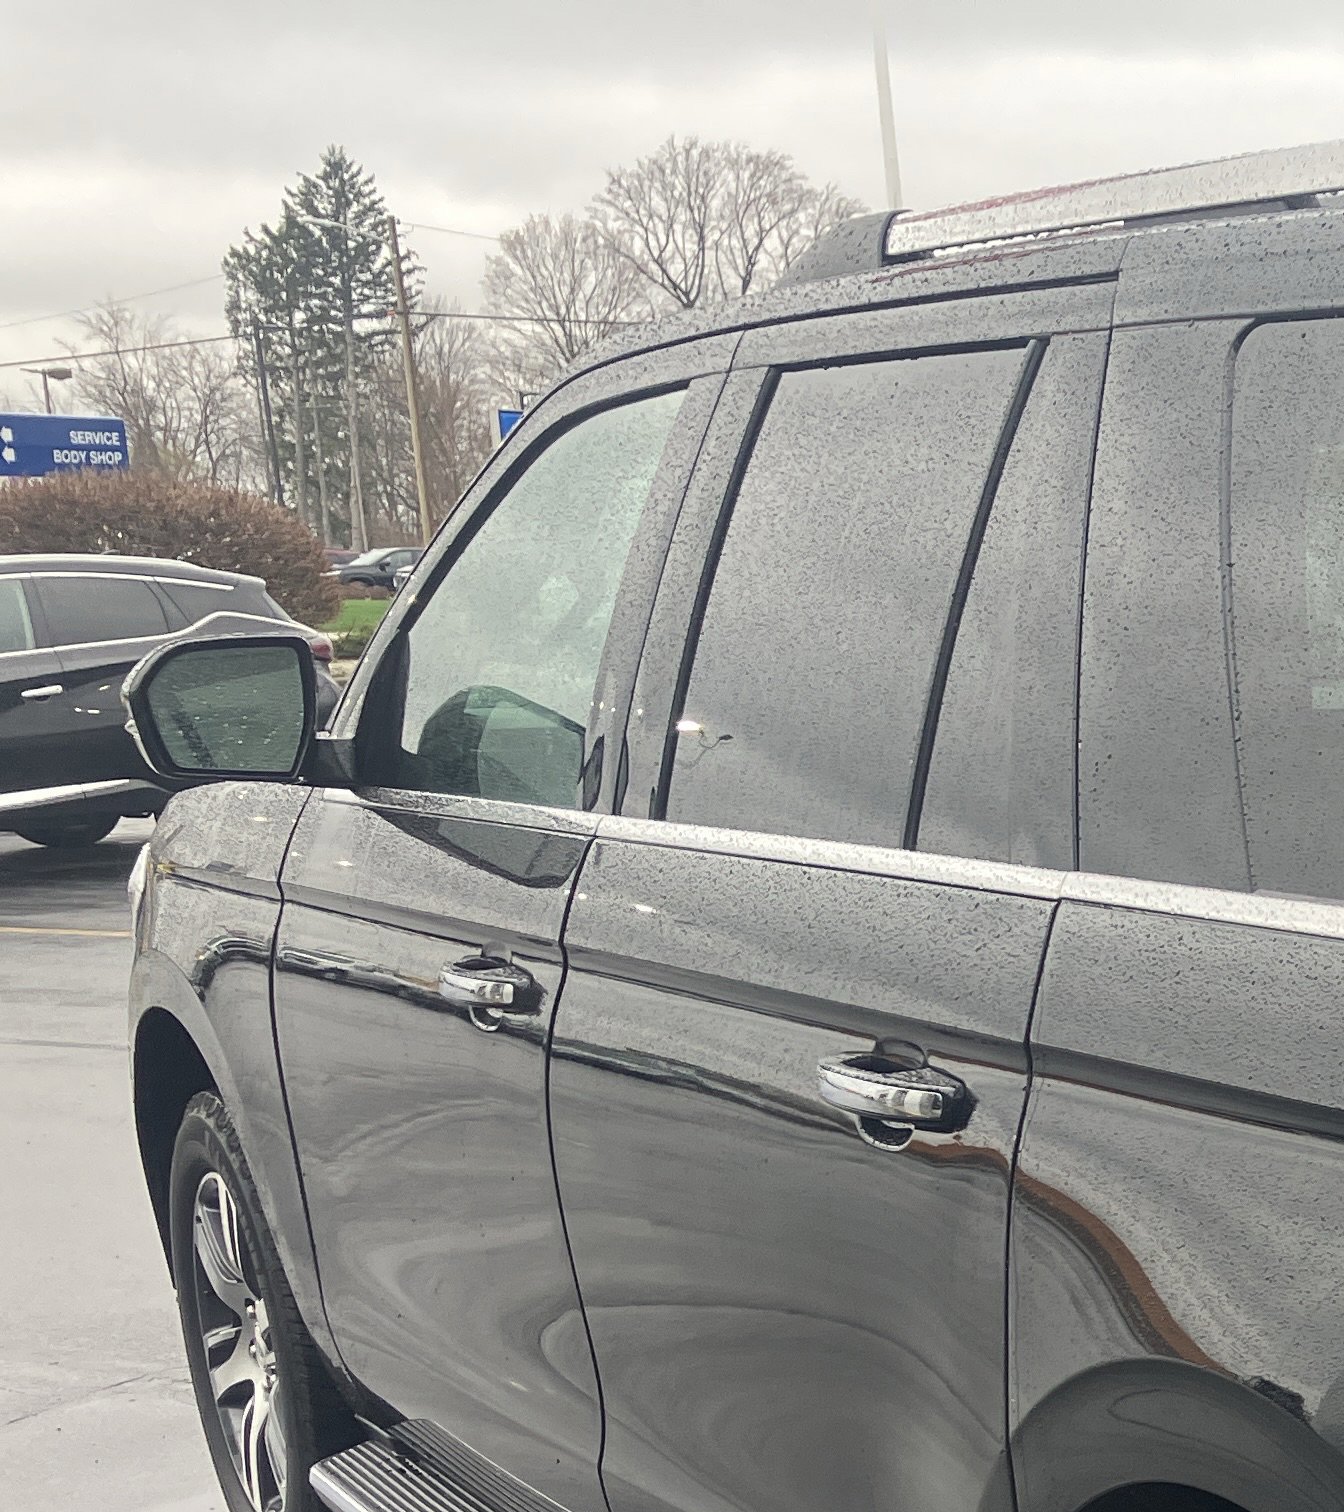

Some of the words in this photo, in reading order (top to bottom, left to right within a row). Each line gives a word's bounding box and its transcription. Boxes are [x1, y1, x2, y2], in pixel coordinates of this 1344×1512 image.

[69, 430, 121, 446] SERVICE
[53, 449, 87, 464] BODY
[89, 450, 123, 465] SHOP
